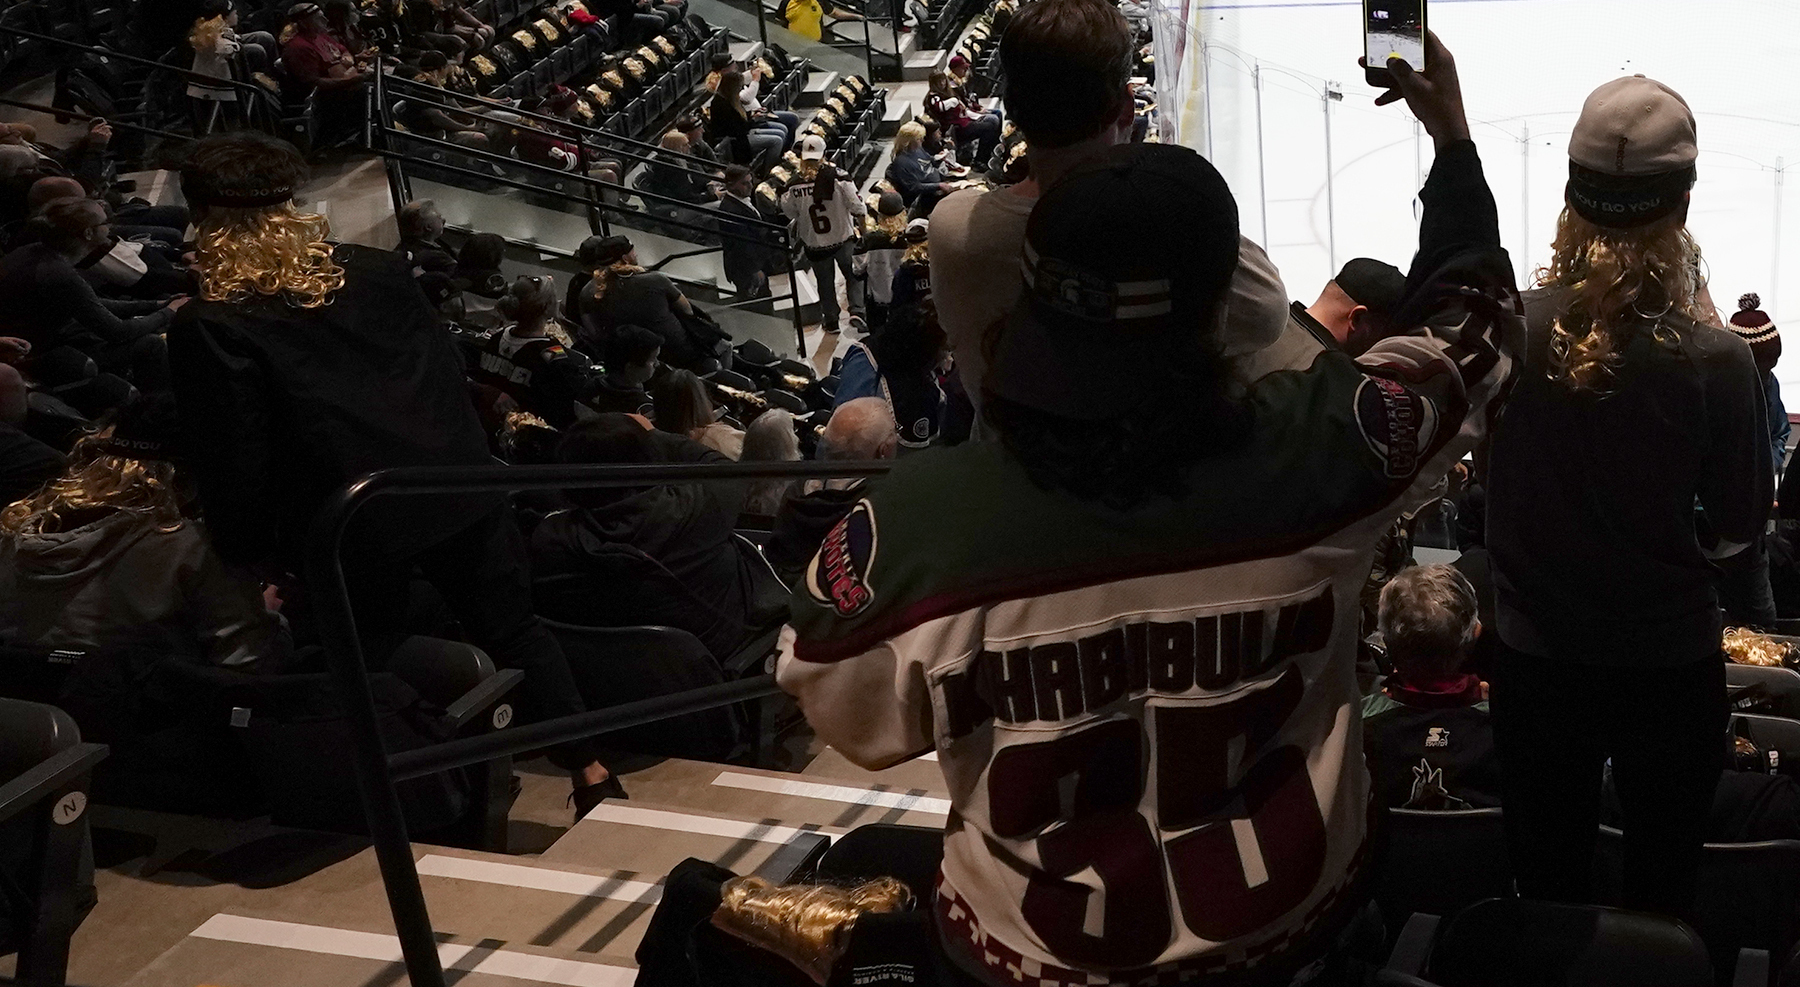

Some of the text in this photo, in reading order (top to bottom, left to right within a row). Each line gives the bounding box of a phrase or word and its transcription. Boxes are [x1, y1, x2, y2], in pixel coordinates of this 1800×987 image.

[1572, 187, 1661, 215] YOU DO YOU
[808, 202, 832, 235] 6
[987, 663, 1328, 968] 35
